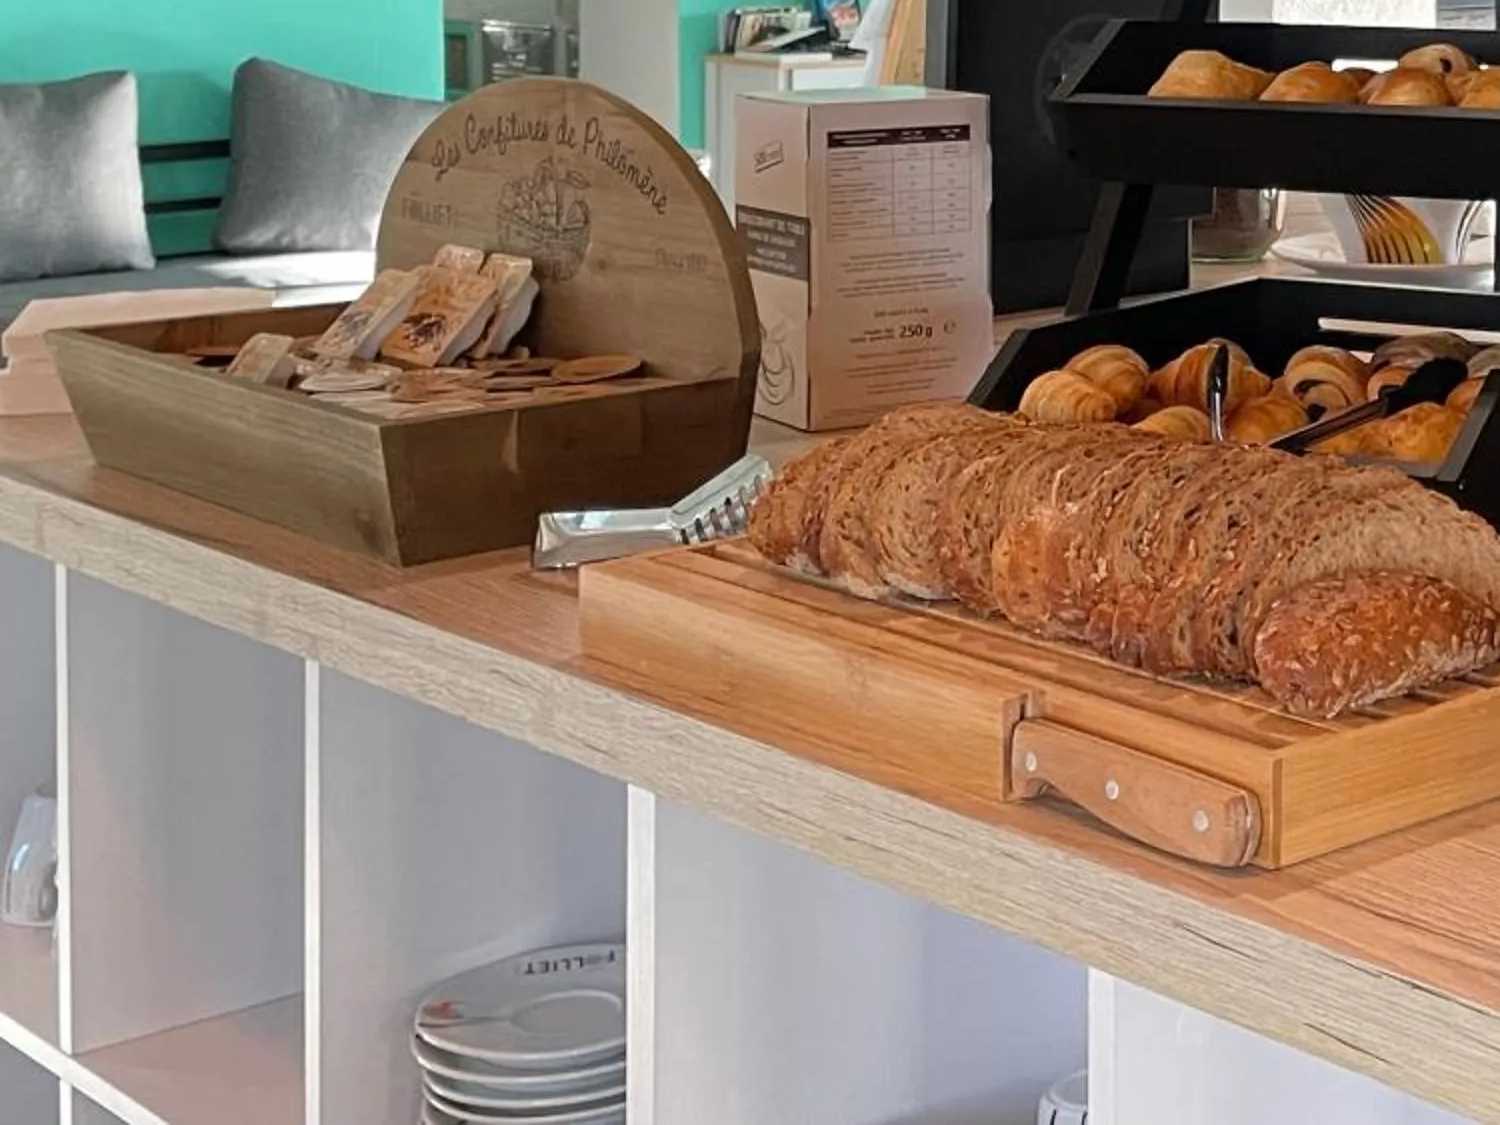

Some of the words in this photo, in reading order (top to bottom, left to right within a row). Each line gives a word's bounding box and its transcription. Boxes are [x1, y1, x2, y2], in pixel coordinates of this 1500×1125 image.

[465, 112, 550, 156] Confitures
[556, 115, 577, 149] de
[899, 323, 923, 338] 250
